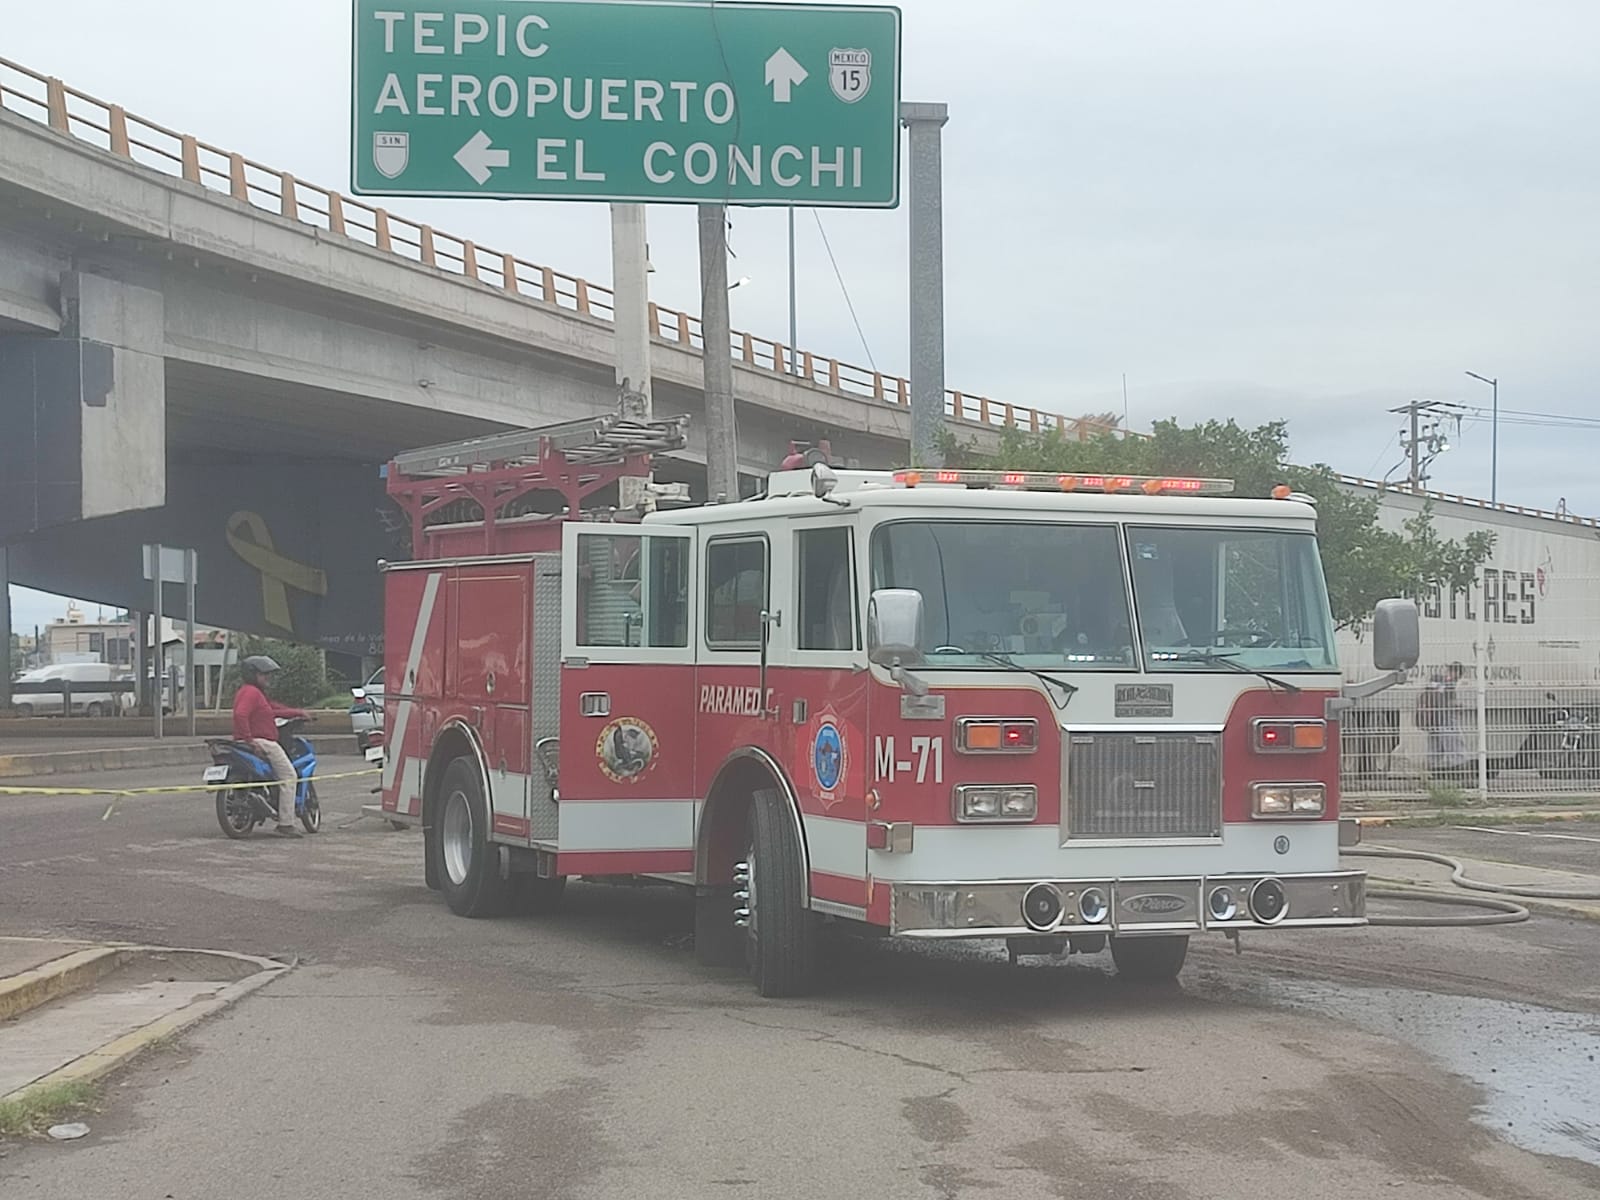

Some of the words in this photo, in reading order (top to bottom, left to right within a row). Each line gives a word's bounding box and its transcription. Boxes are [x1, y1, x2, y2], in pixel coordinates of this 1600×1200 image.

[374, 11, 549, 58] TEPIC
[833, 53, 866, 63] MEXICO
[374, 73, 735, 124] AEROPUERTO
[841, 70, 860, 91] 15
[382, 136, 401, 145] SIN
[537, 138, 606, 181] EL
[643, 141, 862, 187] CONCHI
[700, 685, 774, 716] PARAMEDC
[875, 736, 943, 784] M-71
